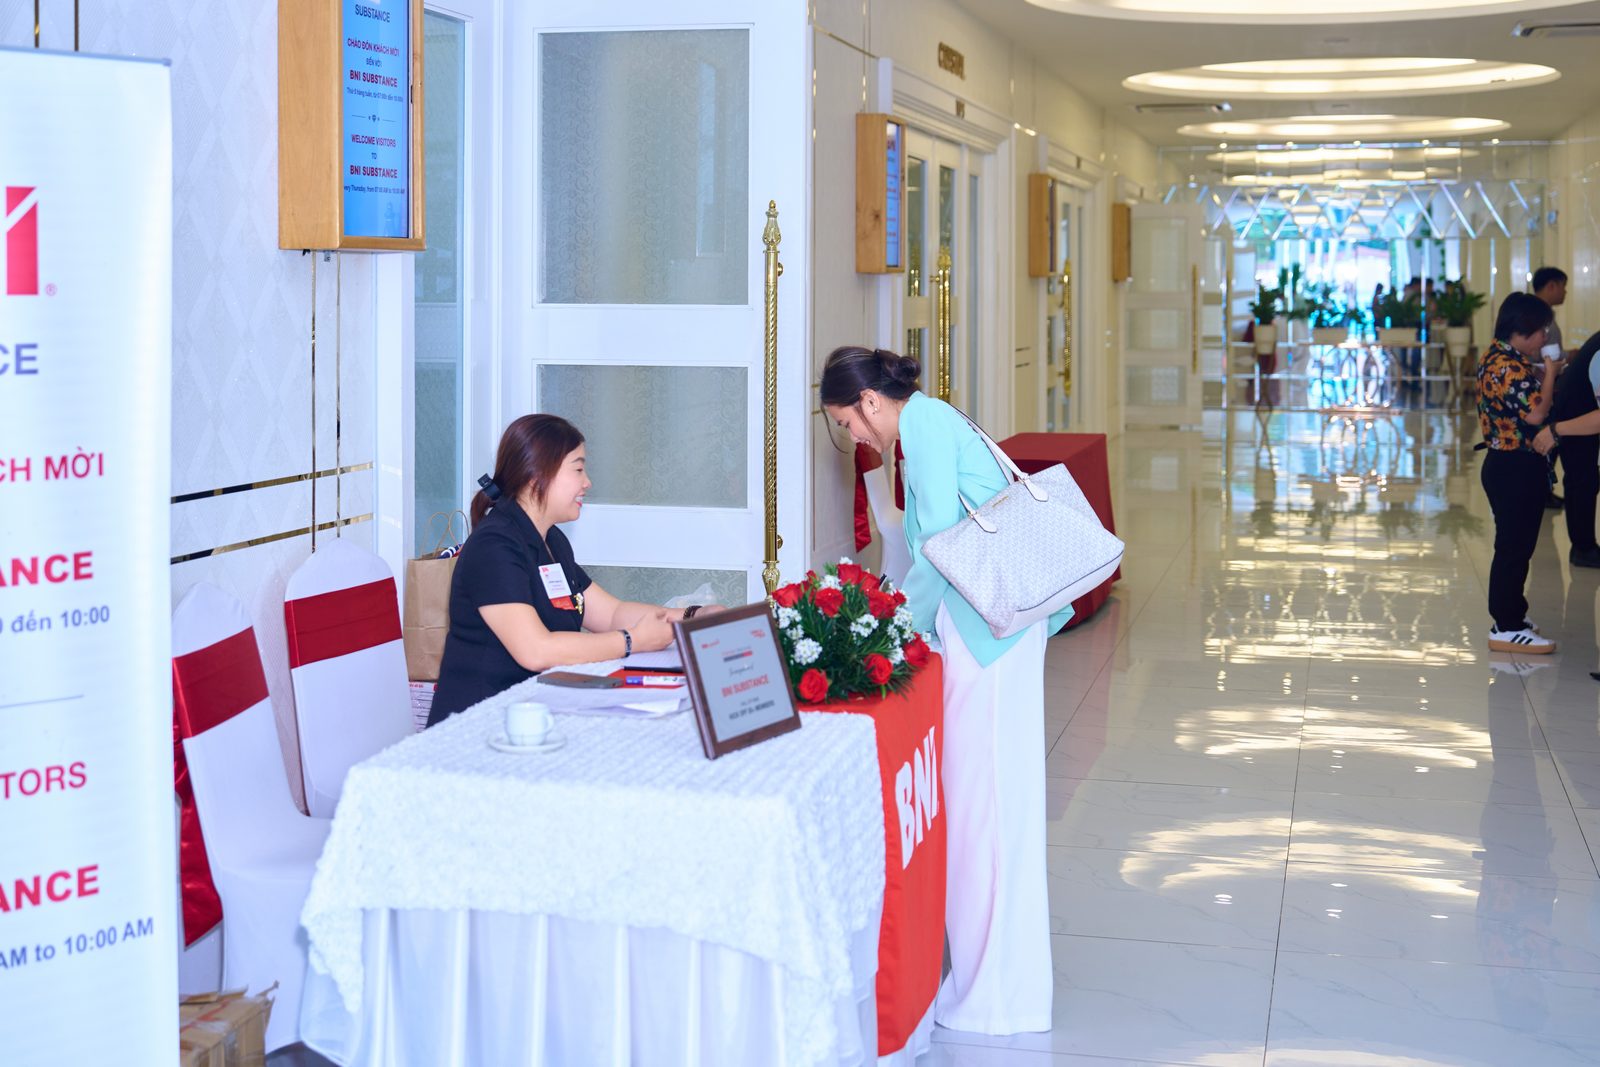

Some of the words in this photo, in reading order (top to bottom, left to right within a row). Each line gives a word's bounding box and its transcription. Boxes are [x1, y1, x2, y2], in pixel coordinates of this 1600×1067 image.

[355, 4, 390, 23] SUBSTANCE
[349, 69, 361, 81] BNI
[362, 72, 398, 87] SUBSTANCE
[351, 134, 375, 145] WELCOME
[375, 137, 397, 148] VISITORS
[371, 152, 378, 160] TO
[349, 165, 361, 176] BNI
[362, 166, 398, 179] SUBSTANCE
[44, 446, 104, 482] MỜI
[0, 551, 94, 589] NCE
[11, 609, 53, 634] đến
[61, 605, 111, 629] 10:00
[895, 725, 939, 871] BNI
[35, 944, 56, 962] to
[64, 926, 117, 956] 10:00
[122, 917, 154, 942] AM
